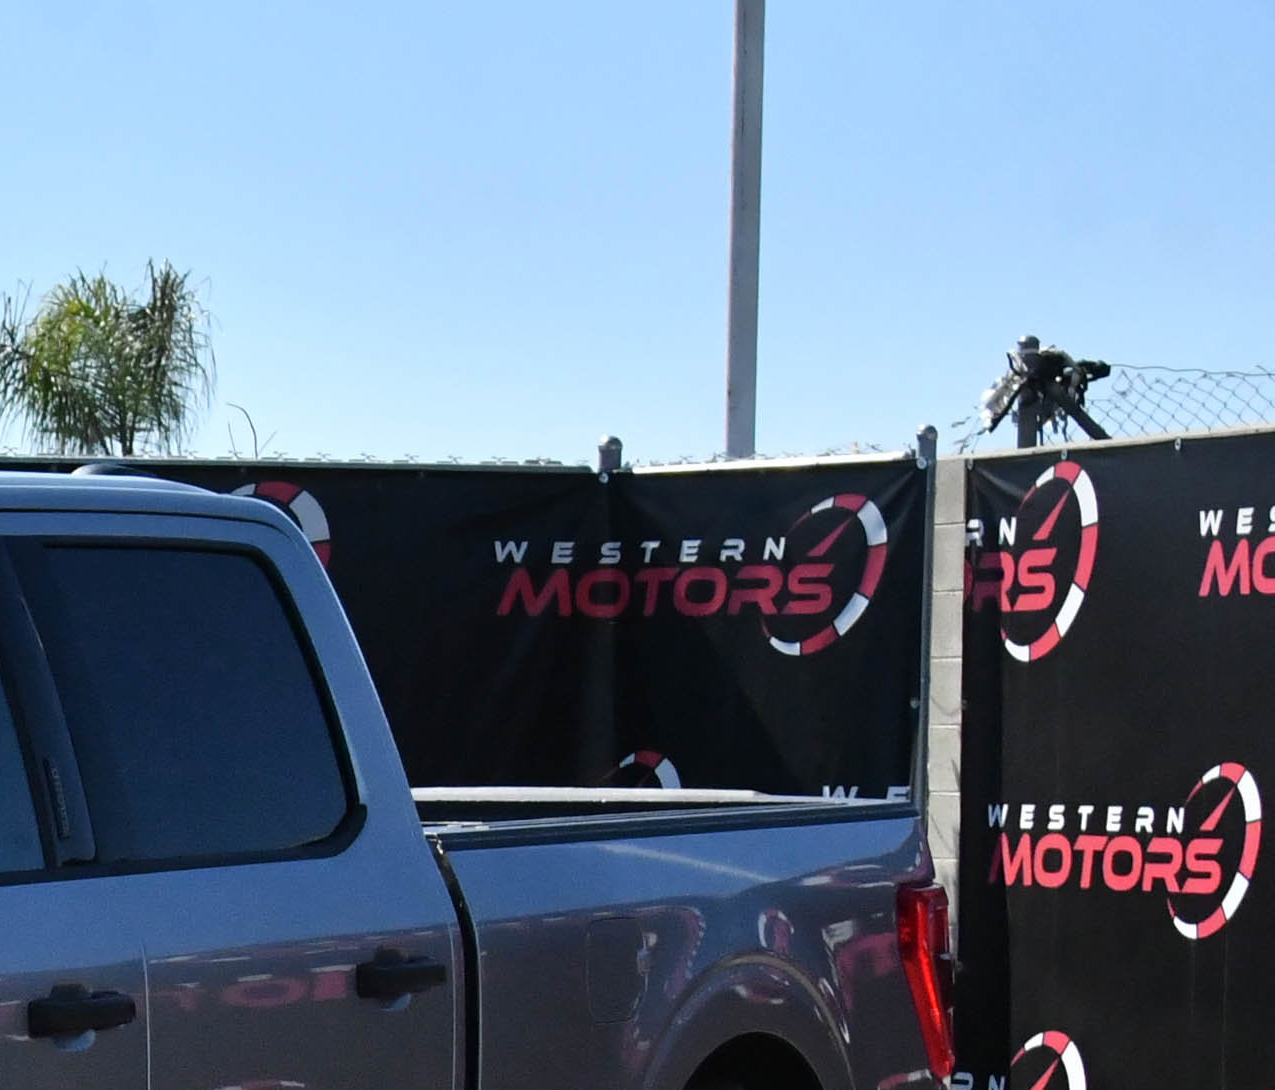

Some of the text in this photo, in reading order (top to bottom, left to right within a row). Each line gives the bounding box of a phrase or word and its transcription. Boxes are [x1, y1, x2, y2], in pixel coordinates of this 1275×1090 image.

[494, 537, 786, 564] WESTERN
[496, 563, 835, 618] MOTORS
[987, 804, 1185, 834] WESTERN
[988, 832, 1224, 894] MOTORS
